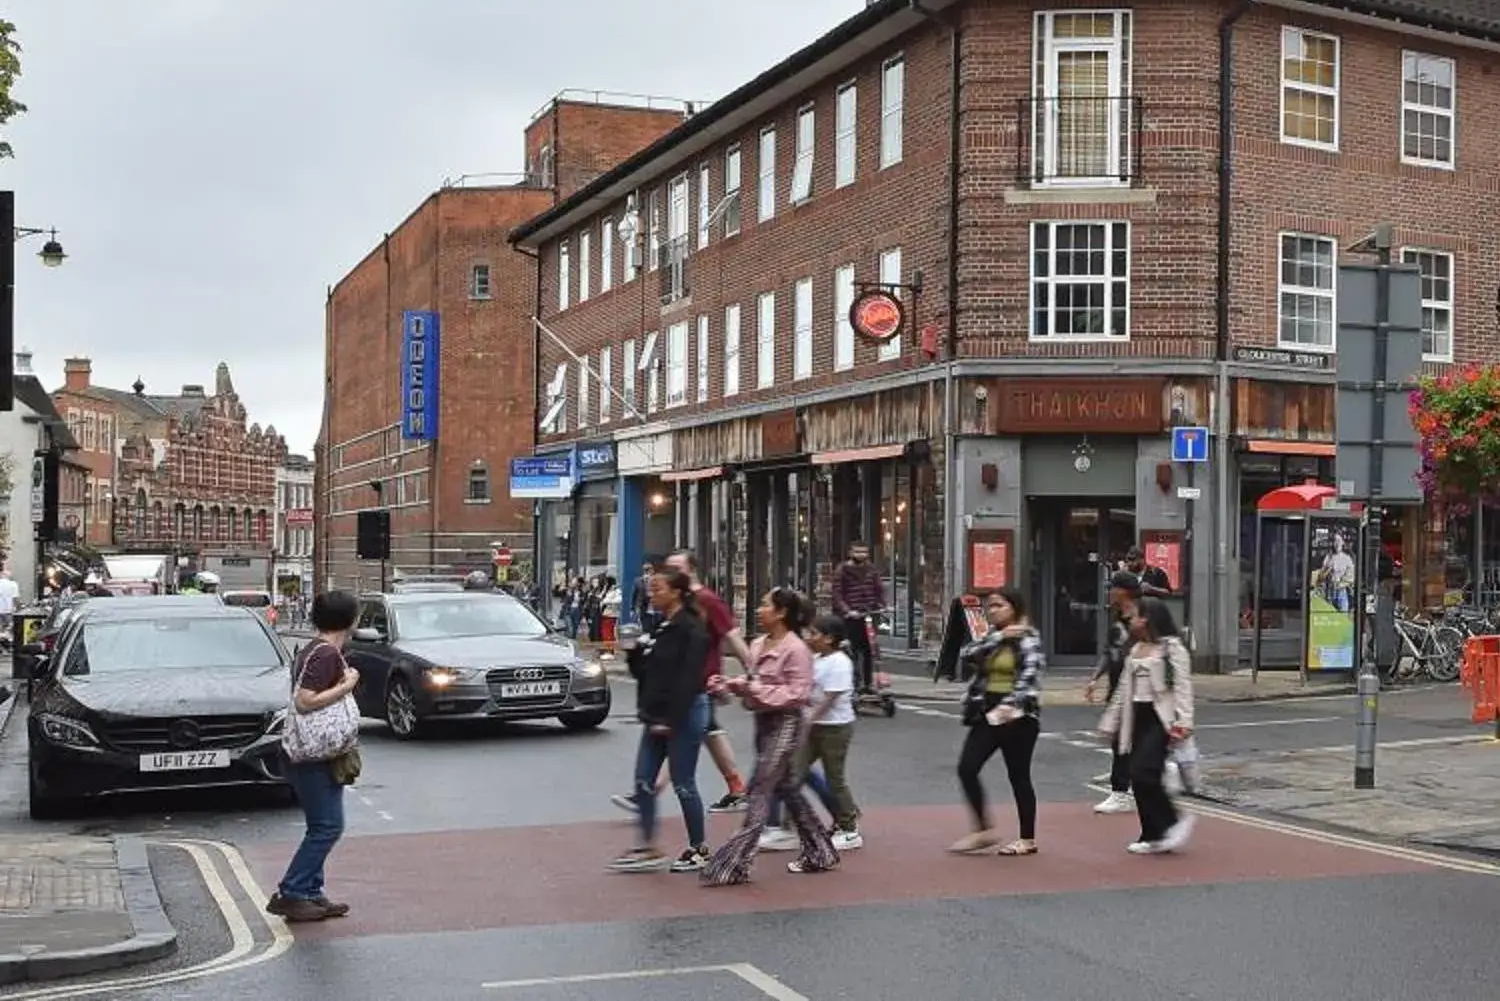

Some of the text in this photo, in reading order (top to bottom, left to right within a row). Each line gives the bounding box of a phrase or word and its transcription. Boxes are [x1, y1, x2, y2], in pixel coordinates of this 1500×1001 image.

[1237, 348, 1325, 366] GLOUCESTER STREET
[409, 315, 425, 434] ODEON
[187, 752, 217, 766] ZZZ
